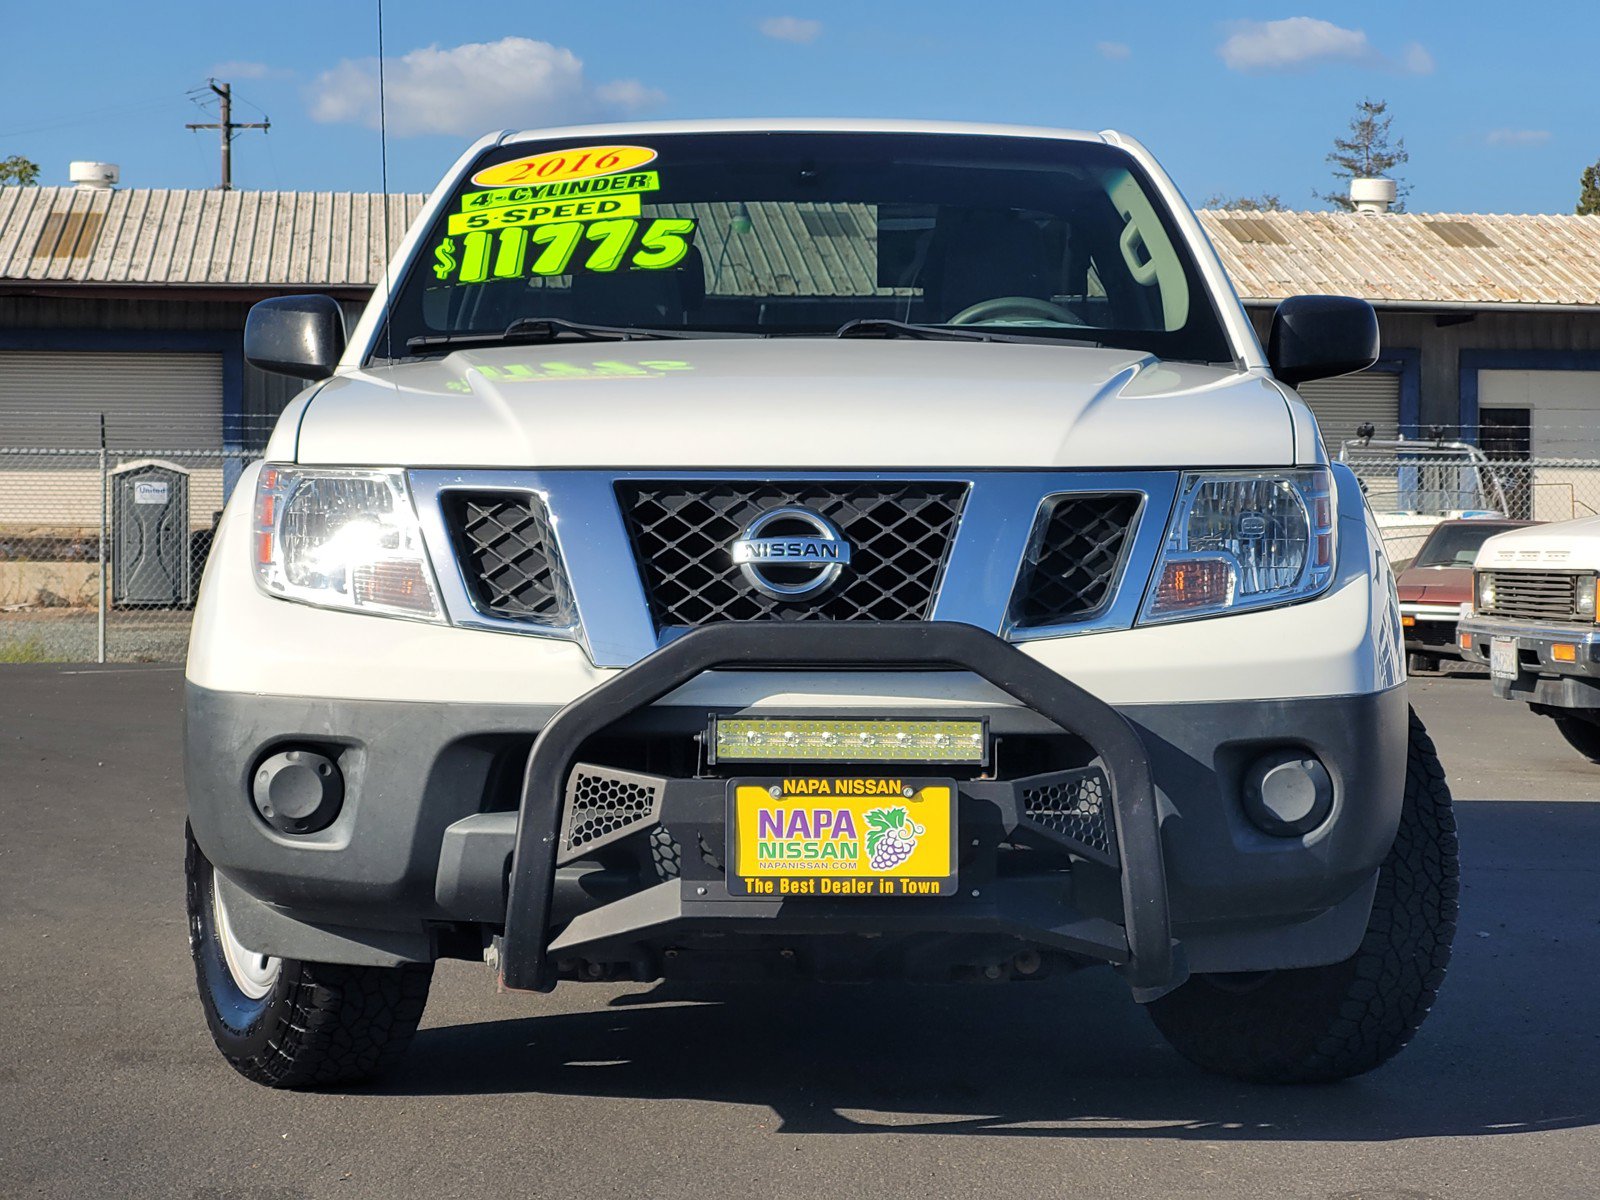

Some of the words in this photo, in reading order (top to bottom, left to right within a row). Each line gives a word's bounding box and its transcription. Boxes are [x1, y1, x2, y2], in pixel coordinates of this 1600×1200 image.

[503, 148, 629, 182] 2016
[469, 174, 651, 207] 4-CYLINDER
[433, 218, 695, 283] $11775
[745, 543, 838, 558] NISSAN
[783, 779, 831, 794] NAPA
[835, 779, 901, 794] NISSAN
[759, 810, 857, 839] NAPA
[759, 842, 858, 859] NISSAN
[745, 878, 773, 894] The
[780, 878, 814, 894] Best
[820, 878, 873, 894] Dealer
[879, 878, 894, 894] in
[900, 878, 940, 894] Town
